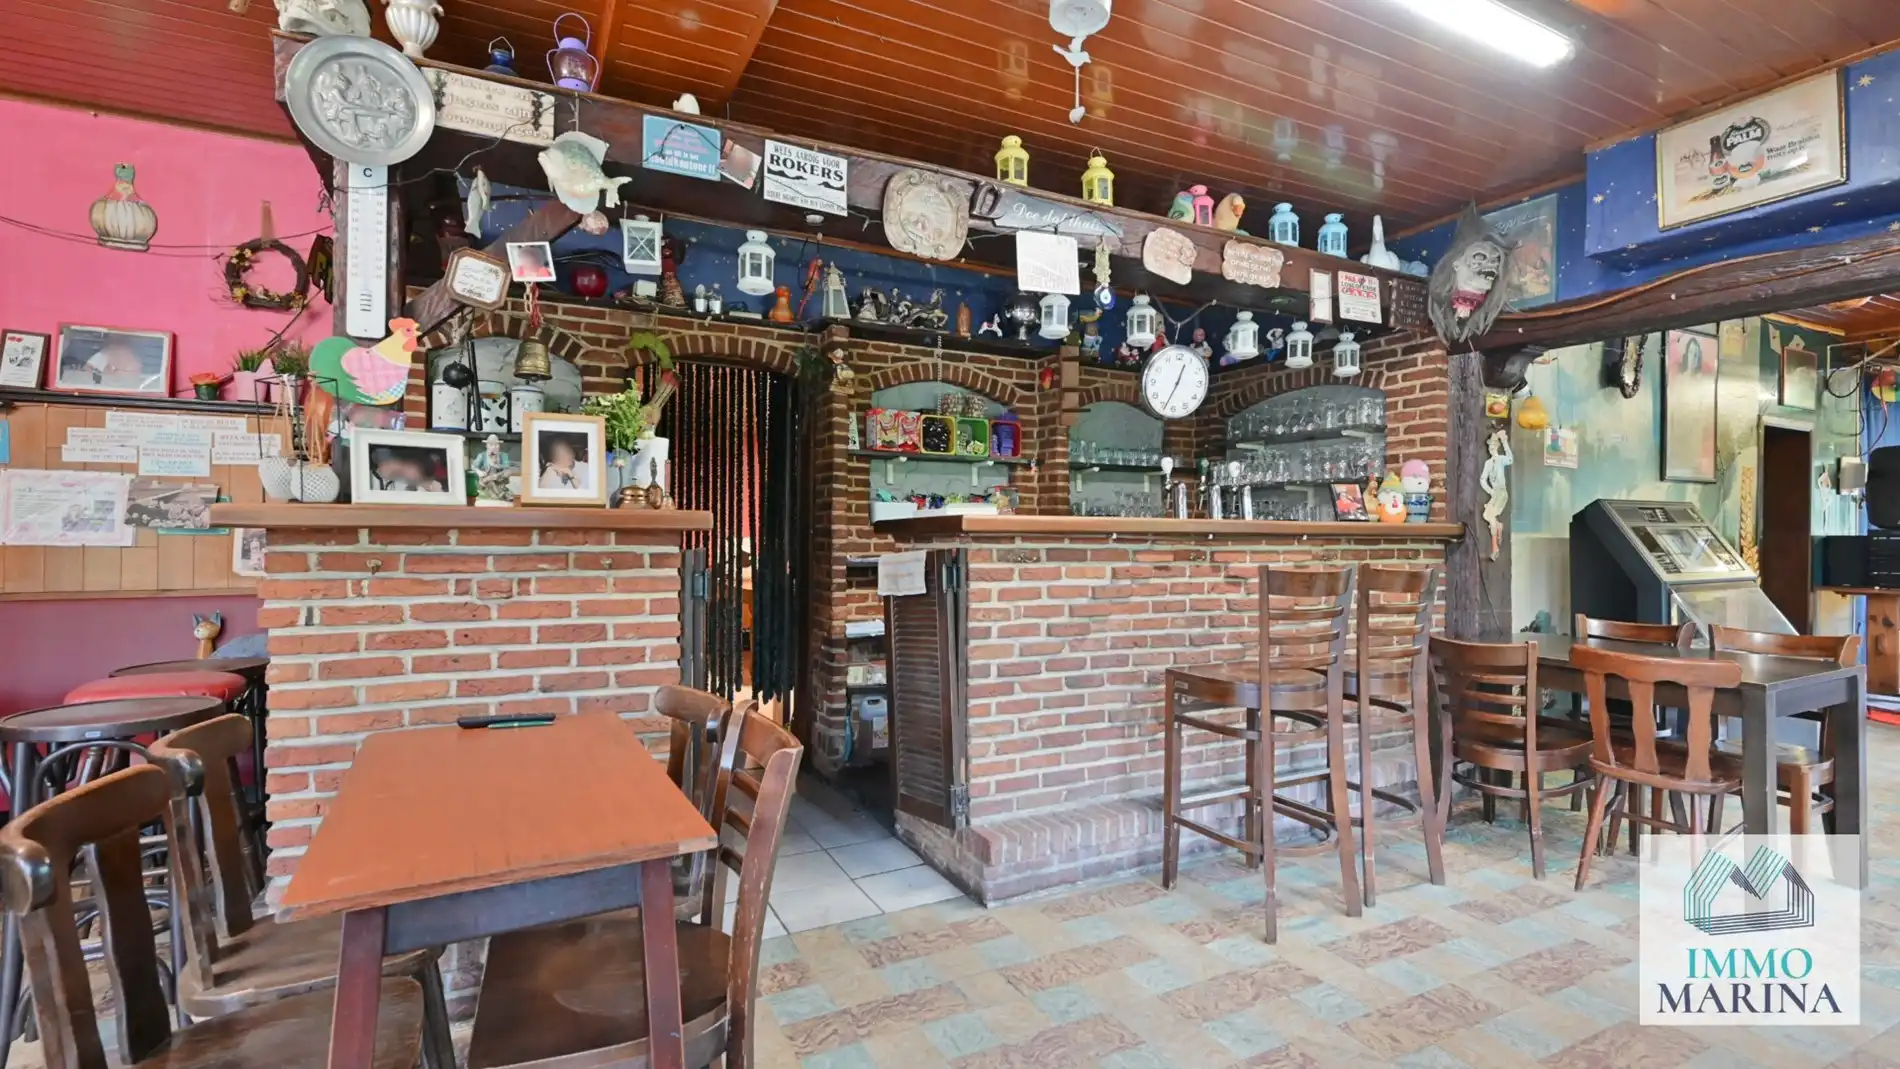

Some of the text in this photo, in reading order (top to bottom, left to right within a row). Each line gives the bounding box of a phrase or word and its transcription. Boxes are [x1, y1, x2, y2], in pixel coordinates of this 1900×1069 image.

[1726, 127, 1762, 148] PALM
[363, 168, 373, 178] C
[769, 153, 844, 182] ROKERS
[1012, 202, 1039, 220] Doe
[1042, 209, 1067, 226] dat
